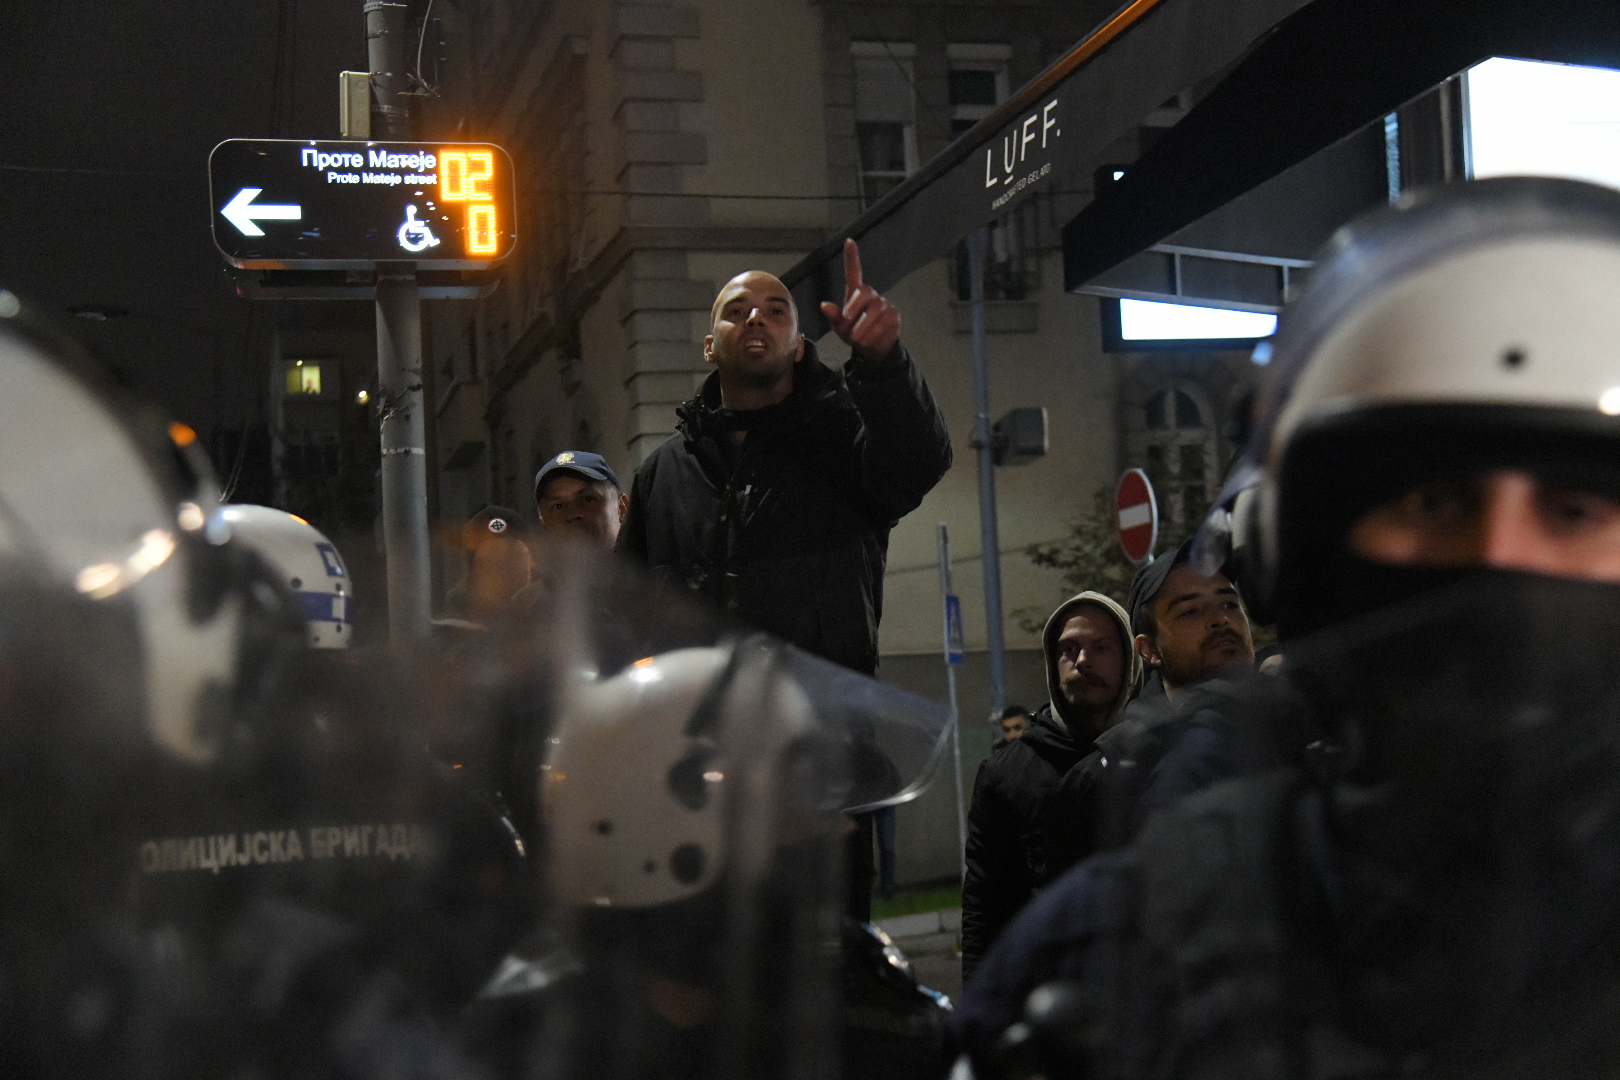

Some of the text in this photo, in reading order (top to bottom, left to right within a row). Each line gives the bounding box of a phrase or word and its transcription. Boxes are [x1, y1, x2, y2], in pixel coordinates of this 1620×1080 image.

[302, 149, 437, 172] Проте Матеје
[439, 150, 494, 201] 02
[327, 172, 438, 186] Prote Mateje street
[141, 829, 305, 875] ОЛИЦИЈСКА
